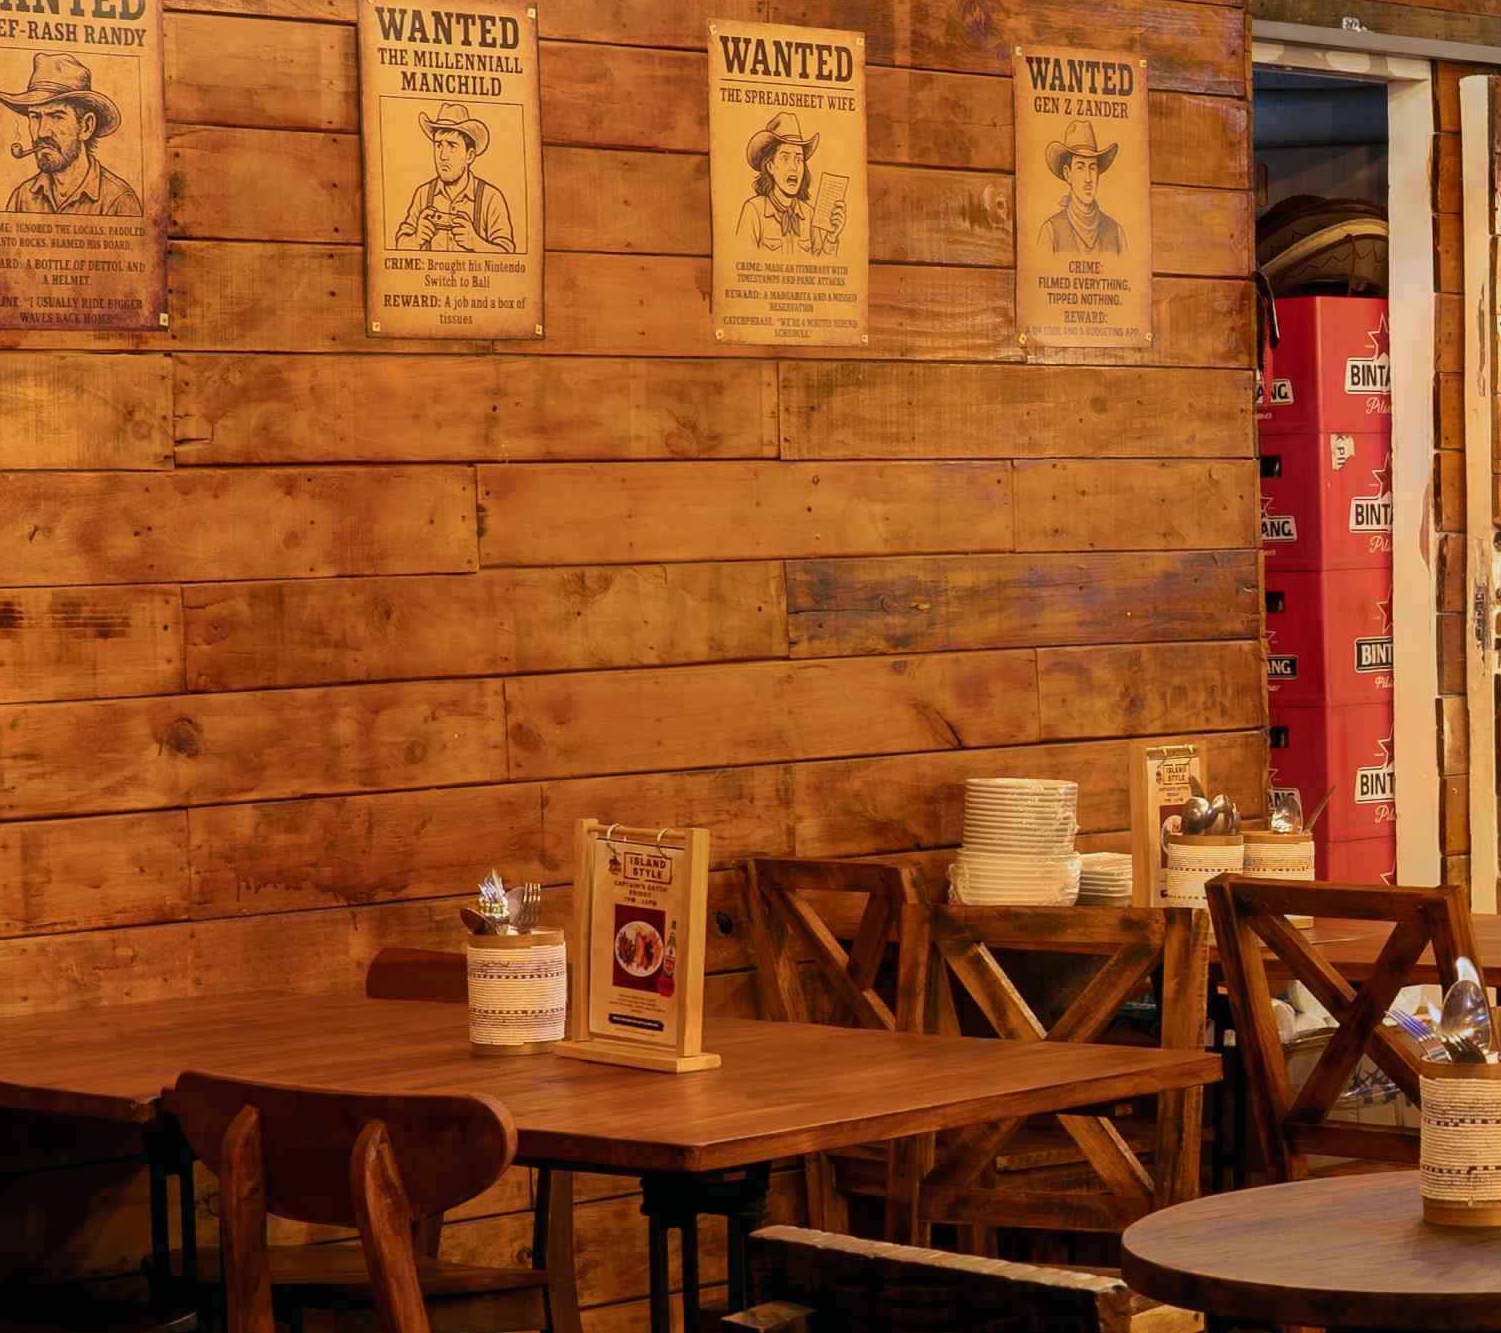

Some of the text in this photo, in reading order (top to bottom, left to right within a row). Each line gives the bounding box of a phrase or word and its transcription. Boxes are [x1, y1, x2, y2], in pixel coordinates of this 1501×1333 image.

[84, 25, 147, 47] RANDY
[375, 7, 519, 49] WANTED
[378, 48, 523, 74] THE MILLENNIALL
[719, 36, 853, 82] WANTED
[401, 71, 502, 97] MANCHILD
[1026, 57, 1134, 96] WANTED
[720, 88, 855, 111] THE SPREADSHEET WIFE
[1034, 96, 1129, 119] GEN Z ZANDER
[385, 258, 526, 274] CRIME: Brought his Nintendo
[1069, 261, 1103, 274] CRIME:
[424, 275, 490, 288] Switch to Bali
[1039, 277, 1070, 289] FILMED
[1047, 293, 1078, 305] TIPPED
[1064, 311, 1107, 323] REWARD:
[1355, 504, 1393, 525] BINT
[629, 856, 666, 868] ISLAND
[633, 867, 661, 879] STYLE
